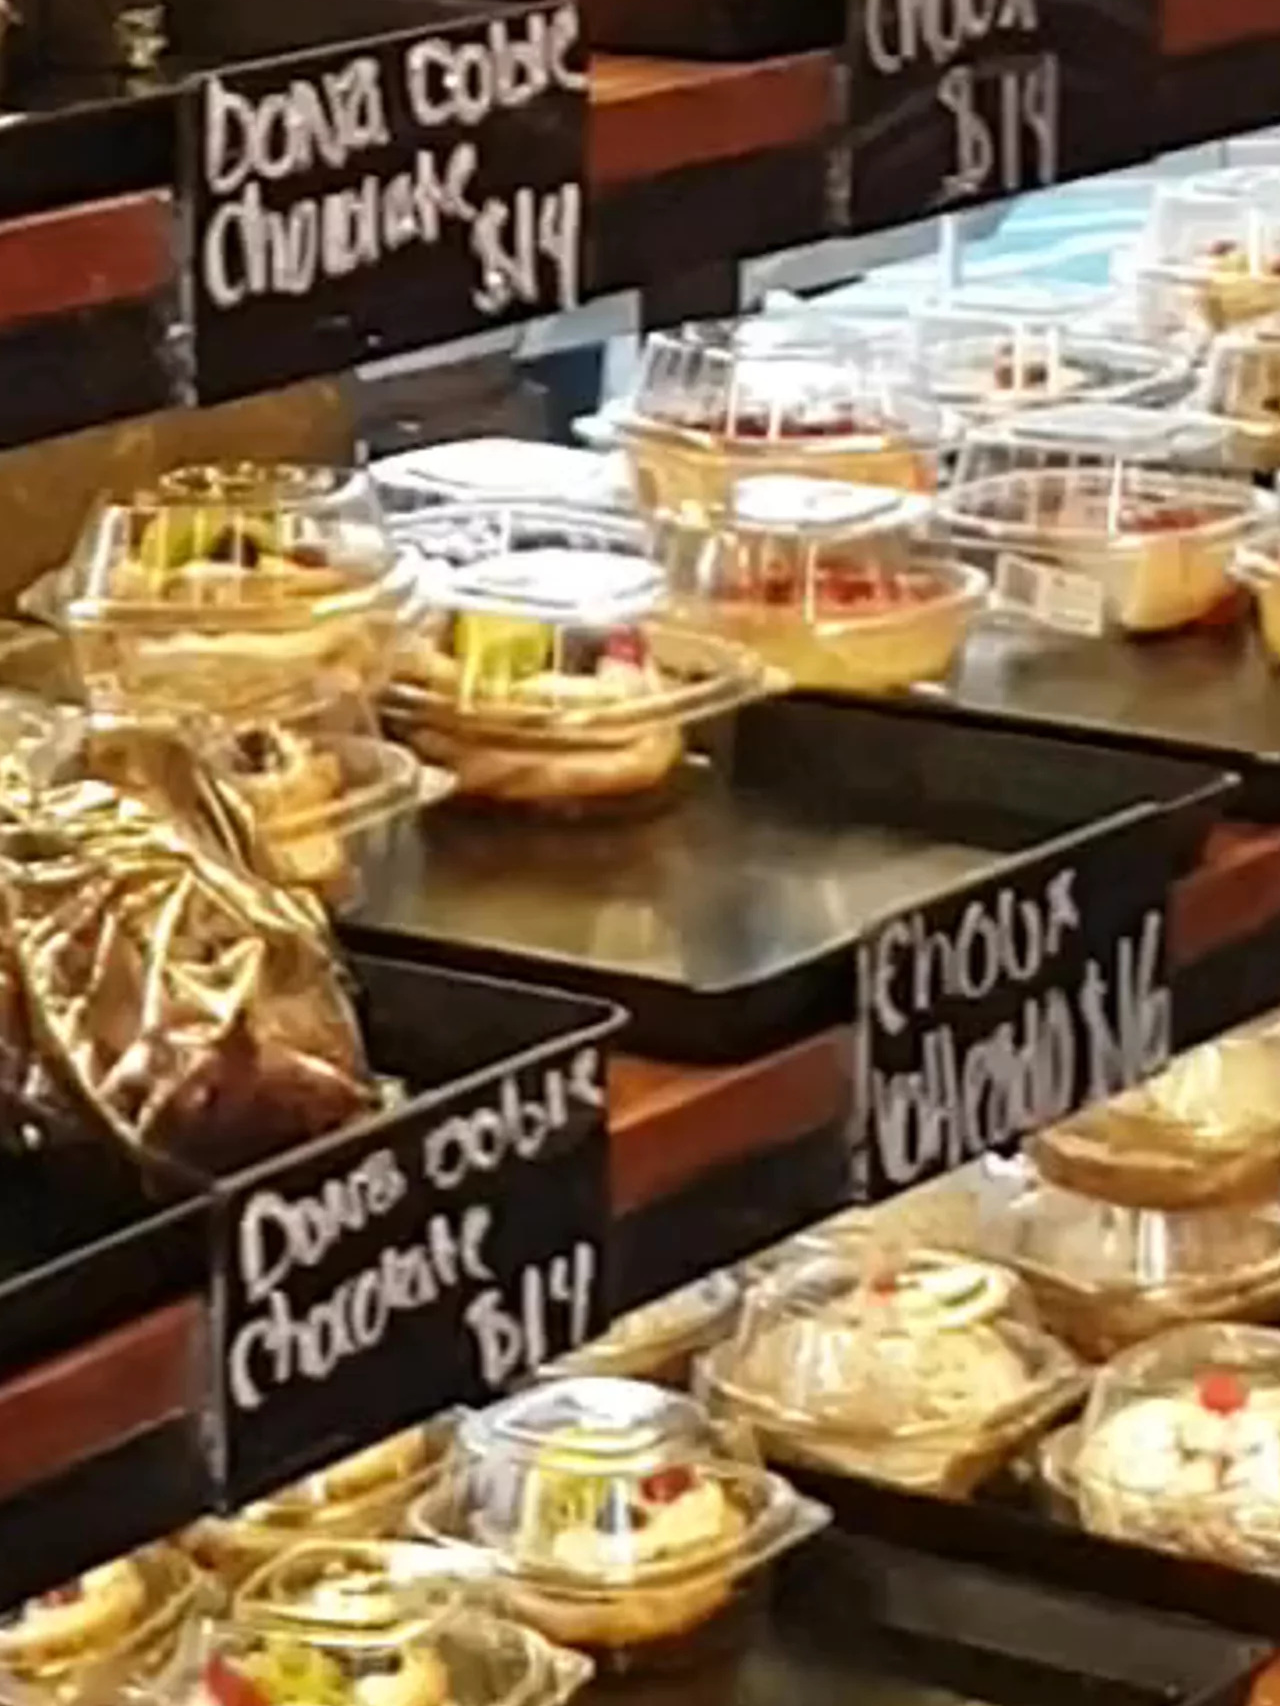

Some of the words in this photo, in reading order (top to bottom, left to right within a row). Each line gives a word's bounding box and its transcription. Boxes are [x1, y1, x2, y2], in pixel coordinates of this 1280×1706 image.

[935, 52, 1058, 198] $14
[470, 183, 581, 314] $14
[464, 1242, 595, 1385] $14
